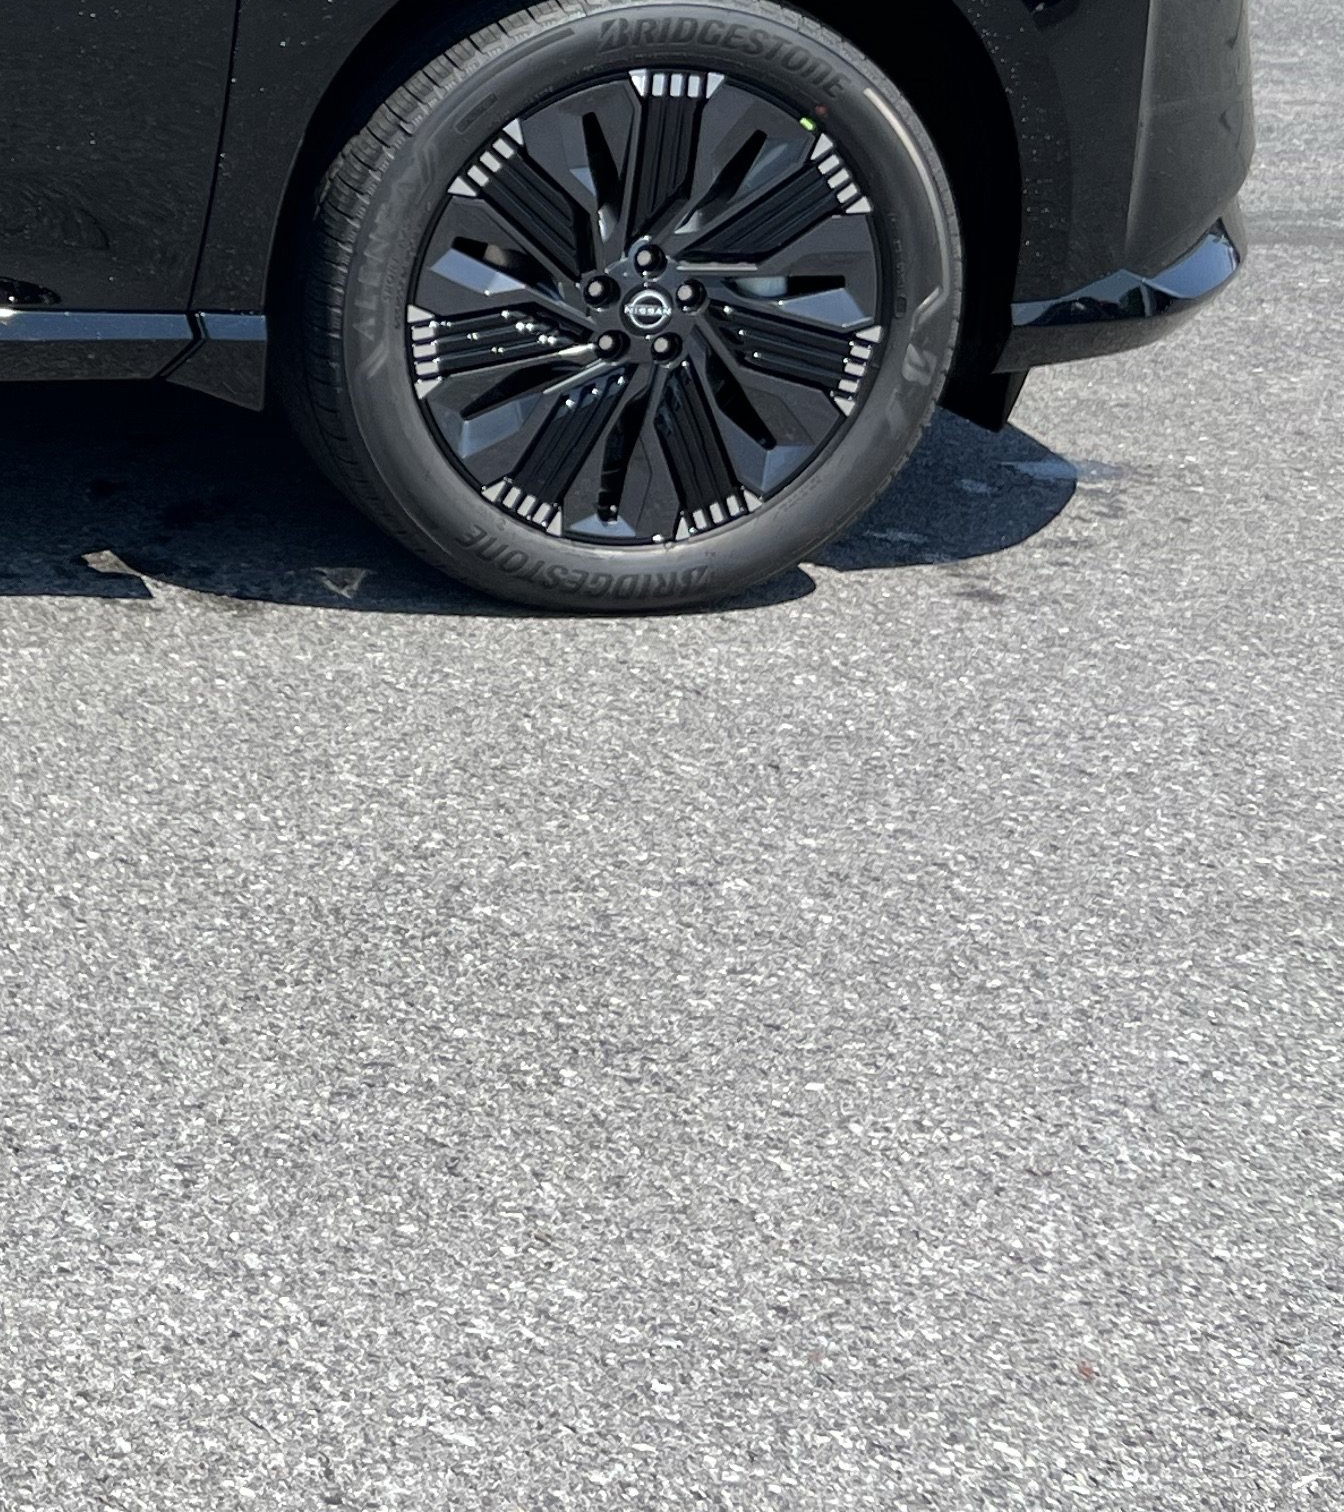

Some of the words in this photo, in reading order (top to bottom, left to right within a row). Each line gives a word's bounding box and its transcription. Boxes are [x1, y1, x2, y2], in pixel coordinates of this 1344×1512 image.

[600, 16, 851, 99] BRIDGESTONE
[624, 304, 672, 316] NISSAN
[463, 524, 710, 599] BRIDGESTONE
